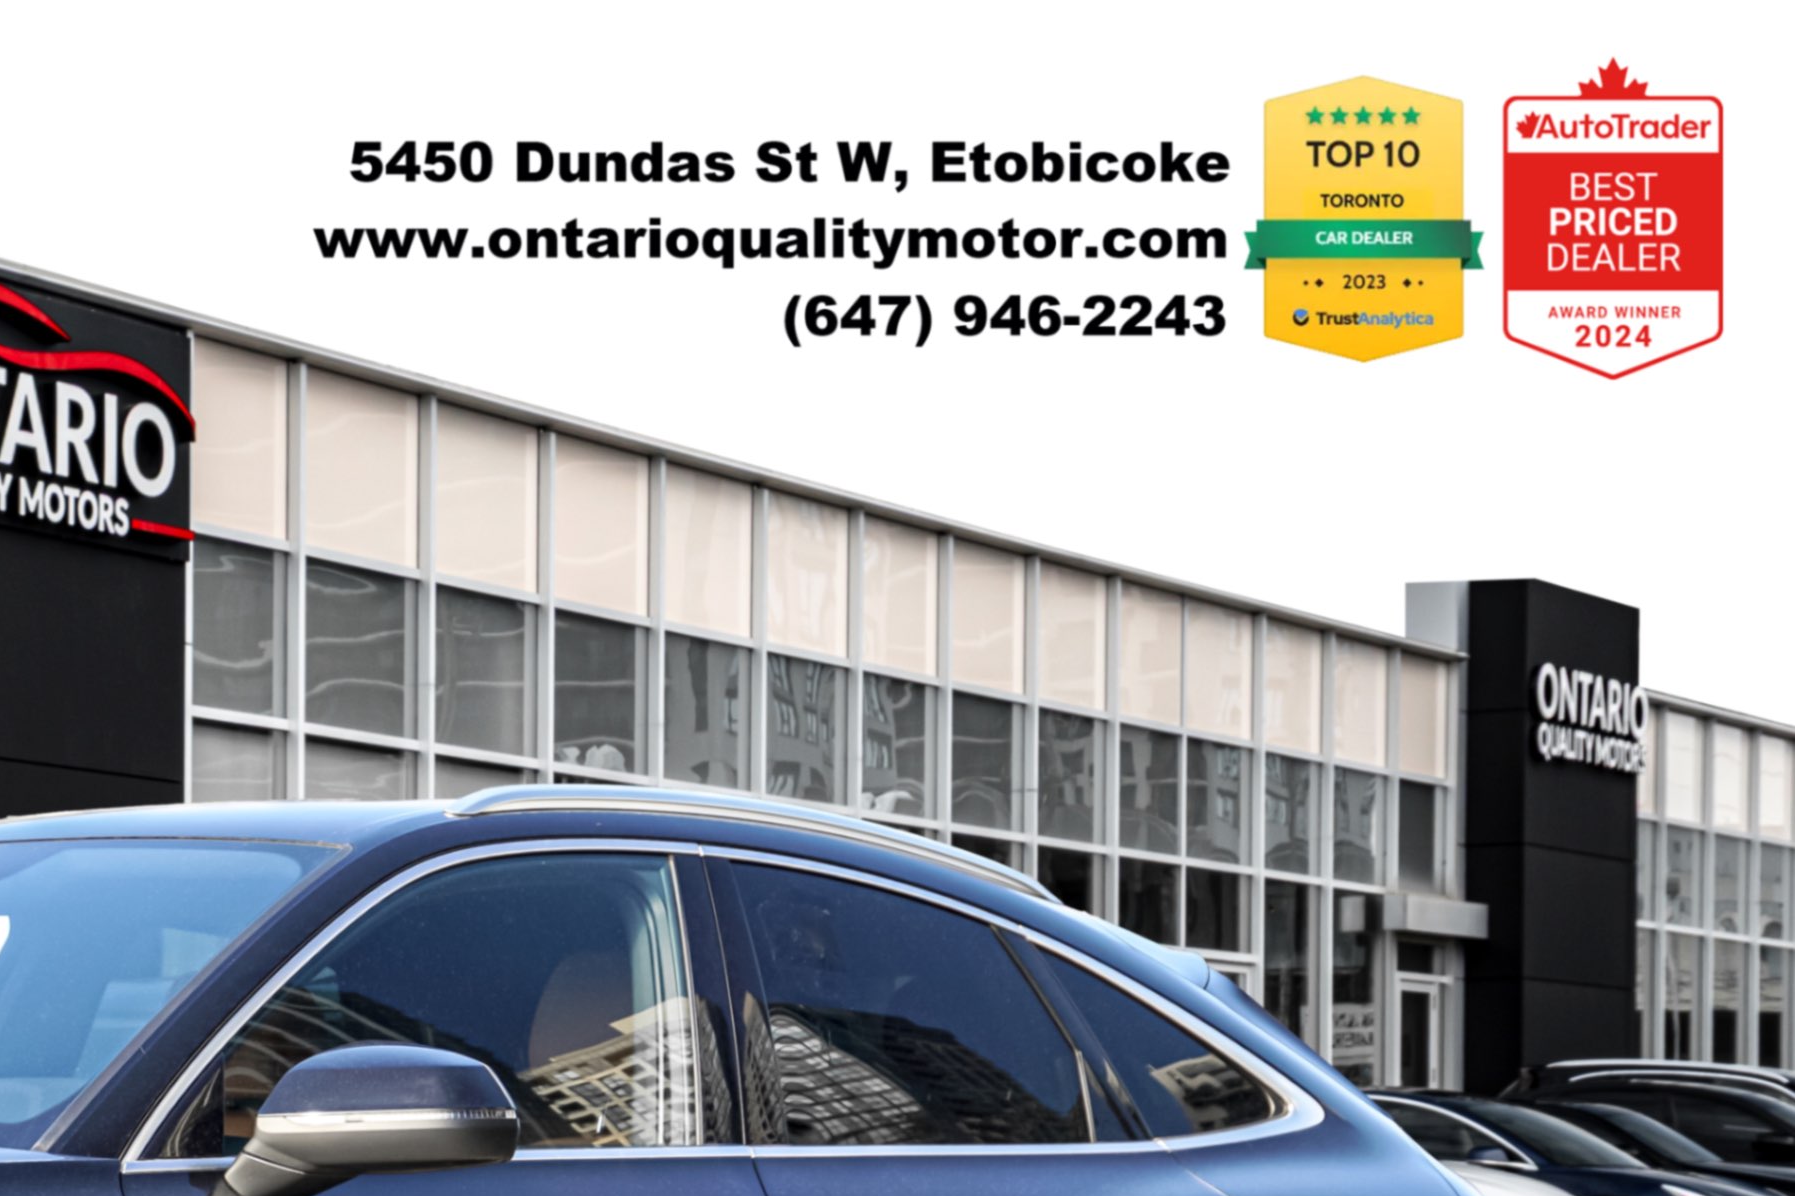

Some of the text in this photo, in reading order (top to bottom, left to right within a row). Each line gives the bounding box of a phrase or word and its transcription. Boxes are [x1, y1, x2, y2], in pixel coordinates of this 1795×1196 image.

[18, 476, 130, 537] MOTORS
[1537, 662, 1649, 740] ONTARIO
[1537, 722, 1595, 763] QUALITY
